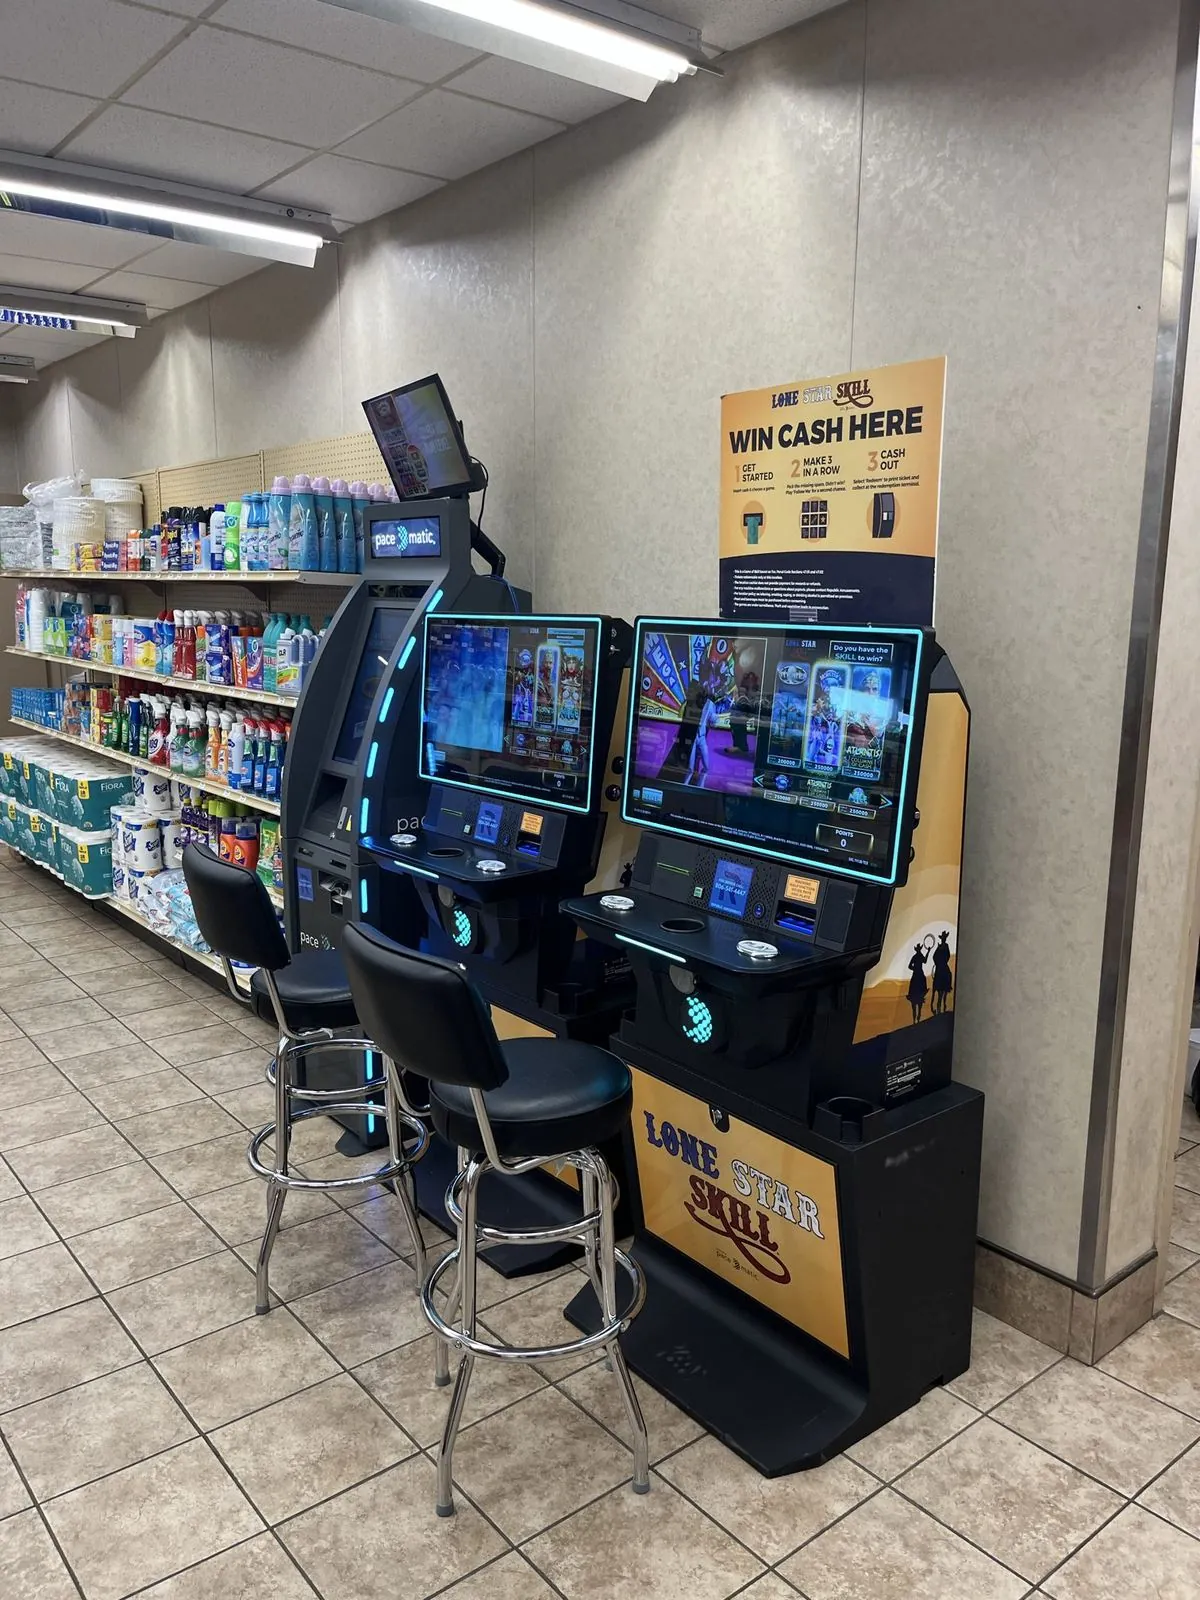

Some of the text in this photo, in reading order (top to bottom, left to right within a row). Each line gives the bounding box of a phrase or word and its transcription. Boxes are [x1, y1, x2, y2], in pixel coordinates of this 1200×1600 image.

[772, 379, 873, 409] LONE STAR SKILL
[729, 405, 923, 454] WIN CASH HERE
[803, 455, 833, 467] MAKE 3
[868, 451, 878, 472] 3
[880, 448, 906, 459] CASH
[735, 465, 740, 483] 1
[742, 463, 756, 473] GET
[791, 459, 801, 478] 2
[803, 465, 841, 477] IN A ROW
[880, 460, 899, 471] OUT
[742, 471, 774, 482] STARTED
[375, 533, 395, 550] pace
[801, 640, 816, 648] STAR
[397, 815, 425, 832] pac
[835, 829, 854, 838] POINTS
[840, 839, 847, 848] 0
[300, 931, 319, 948] pace
[643, 1110, 825, 1239] LONE STAR
[686, 1174, 787, 1272] SKILL
